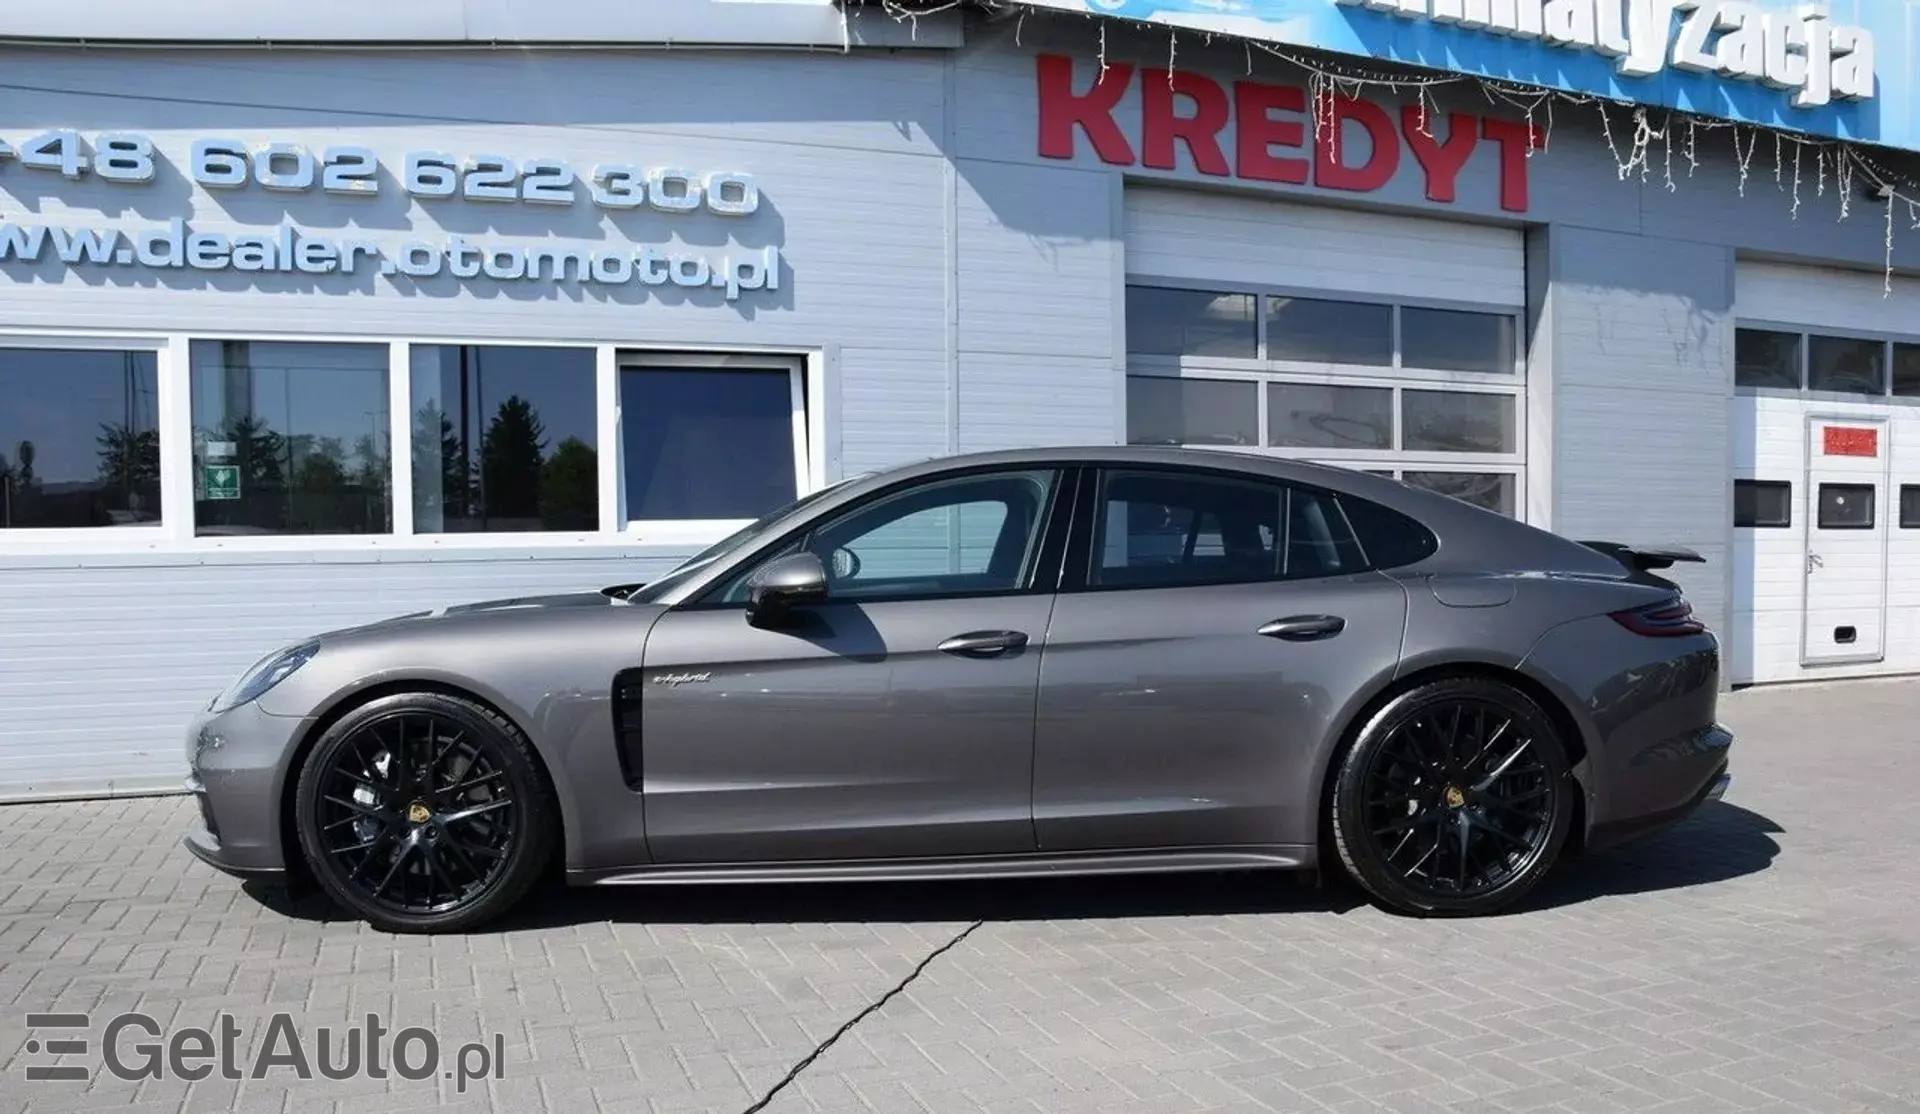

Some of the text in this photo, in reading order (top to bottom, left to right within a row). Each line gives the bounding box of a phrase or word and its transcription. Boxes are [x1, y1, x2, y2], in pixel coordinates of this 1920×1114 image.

[191, 139, 379, 195] 602
[403, 150, 575, 204] 622
[591, 163, 760, 216] 300
[1036, 54, 1545, 212] KREDYT
